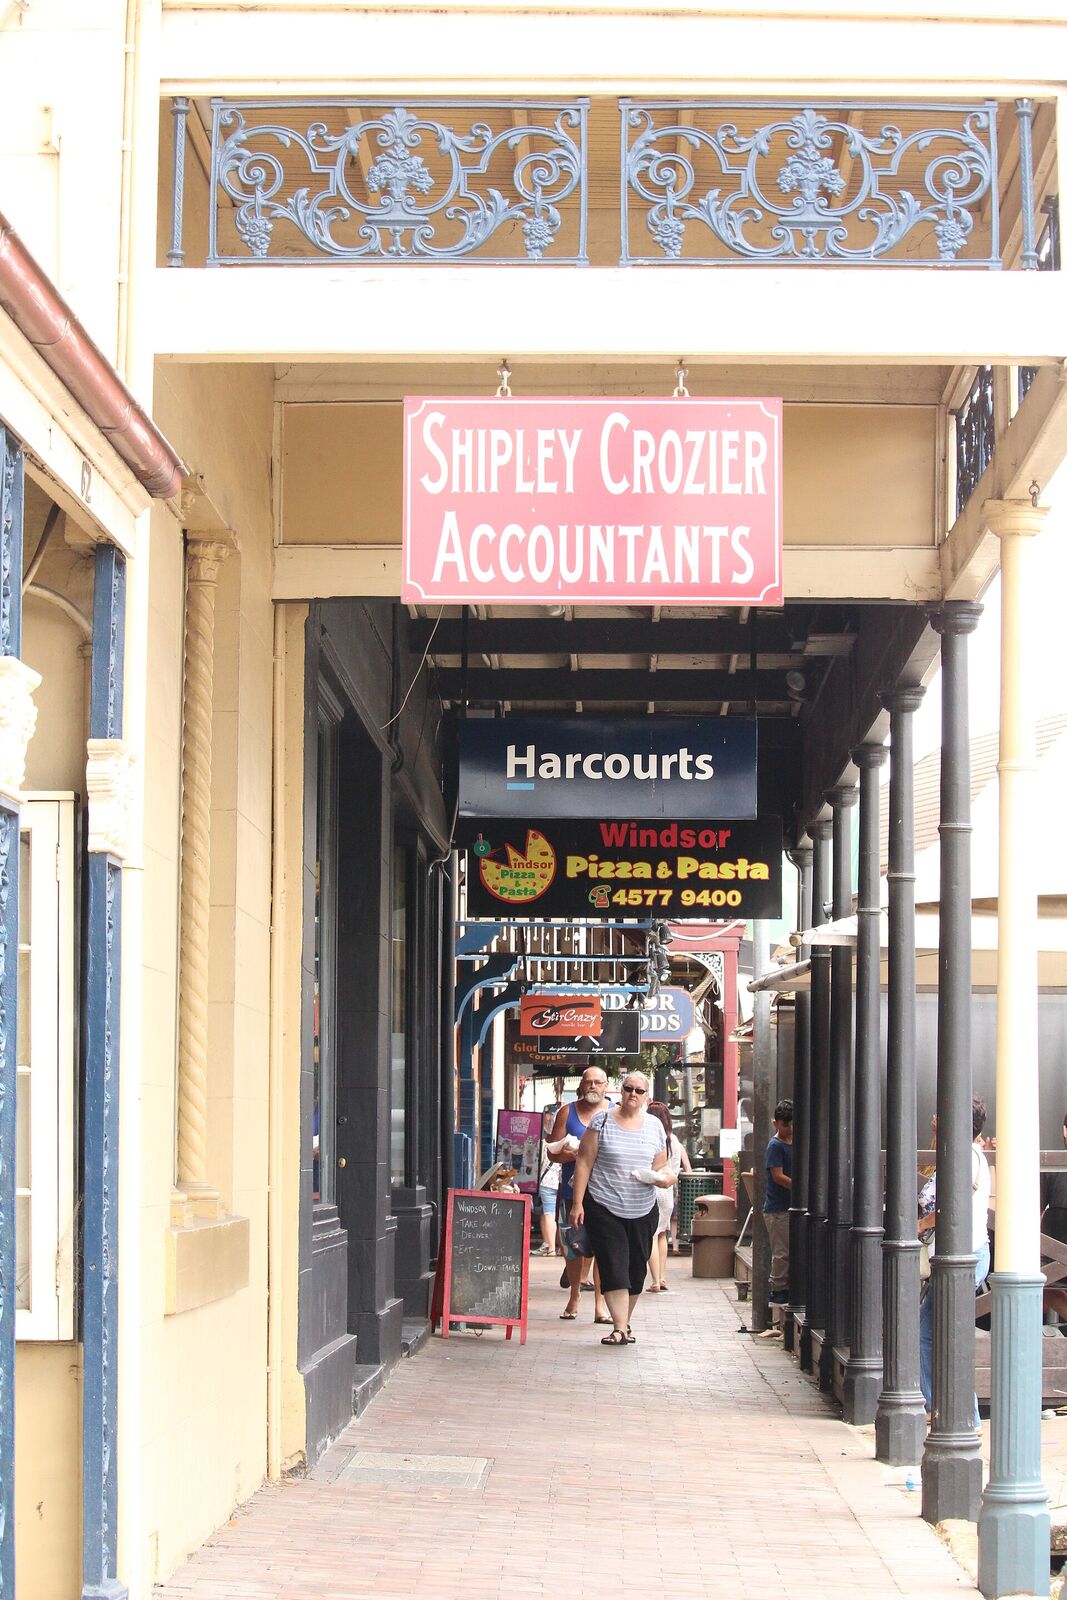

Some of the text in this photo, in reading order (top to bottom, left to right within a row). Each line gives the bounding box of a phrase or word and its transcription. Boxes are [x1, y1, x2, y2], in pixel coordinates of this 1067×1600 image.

[420, 412, 768, 496] SHIPLEY CROZIER
[431, 511, 755, 585] ACCOUNTANTS
[506, 744, 714, 780] Harcourts
[599, 822, 731, 848] Windsor
[500, 869, 536, 879] Pizza
[566, 854, 769, 880] Pizza & Pasta
[499, 886, 537, 896] Pasta
[611, 889, 742, 907] 4577 9400
